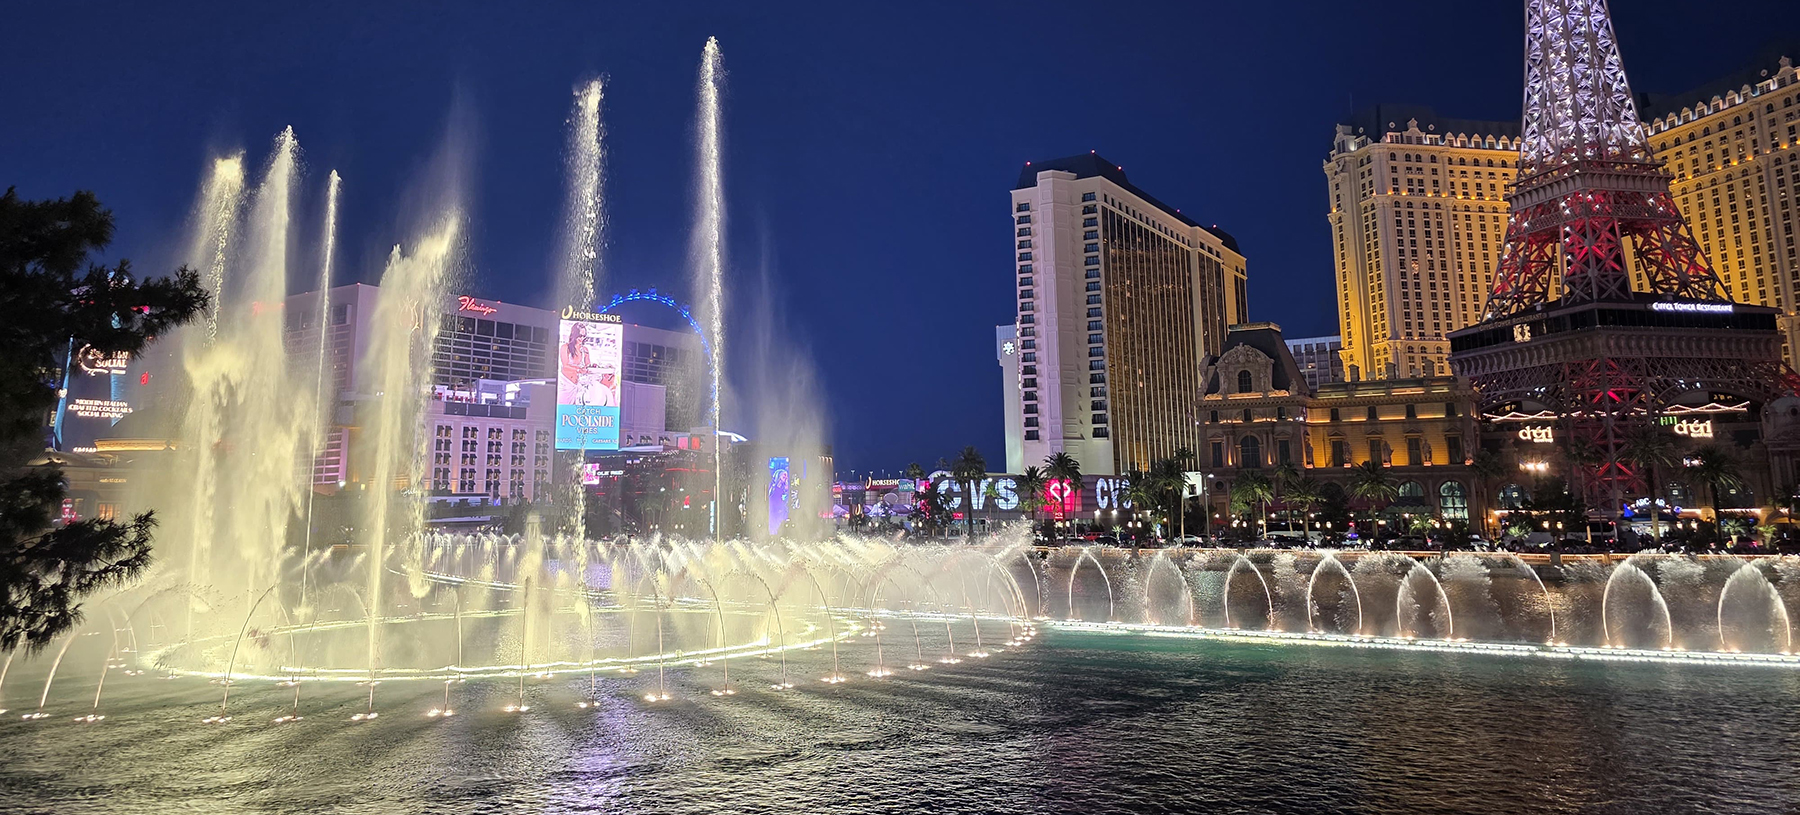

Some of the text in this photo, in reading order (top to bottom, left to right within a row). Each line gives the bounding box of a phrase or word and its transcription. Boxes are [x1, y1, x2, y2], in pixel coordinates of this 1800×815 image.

[458, 296, 497, 315] Flamingo
[573, 311, 621, 322] HORSESHOE
[95, 359, 127, 368] SOCIAL
[576, 407, 601, 415] CATCH
[562, 414, 615, 428] POOLSIDE
[937, 478, 1019, 511] CVS
[1096, 477, 1132, 509] CVS
